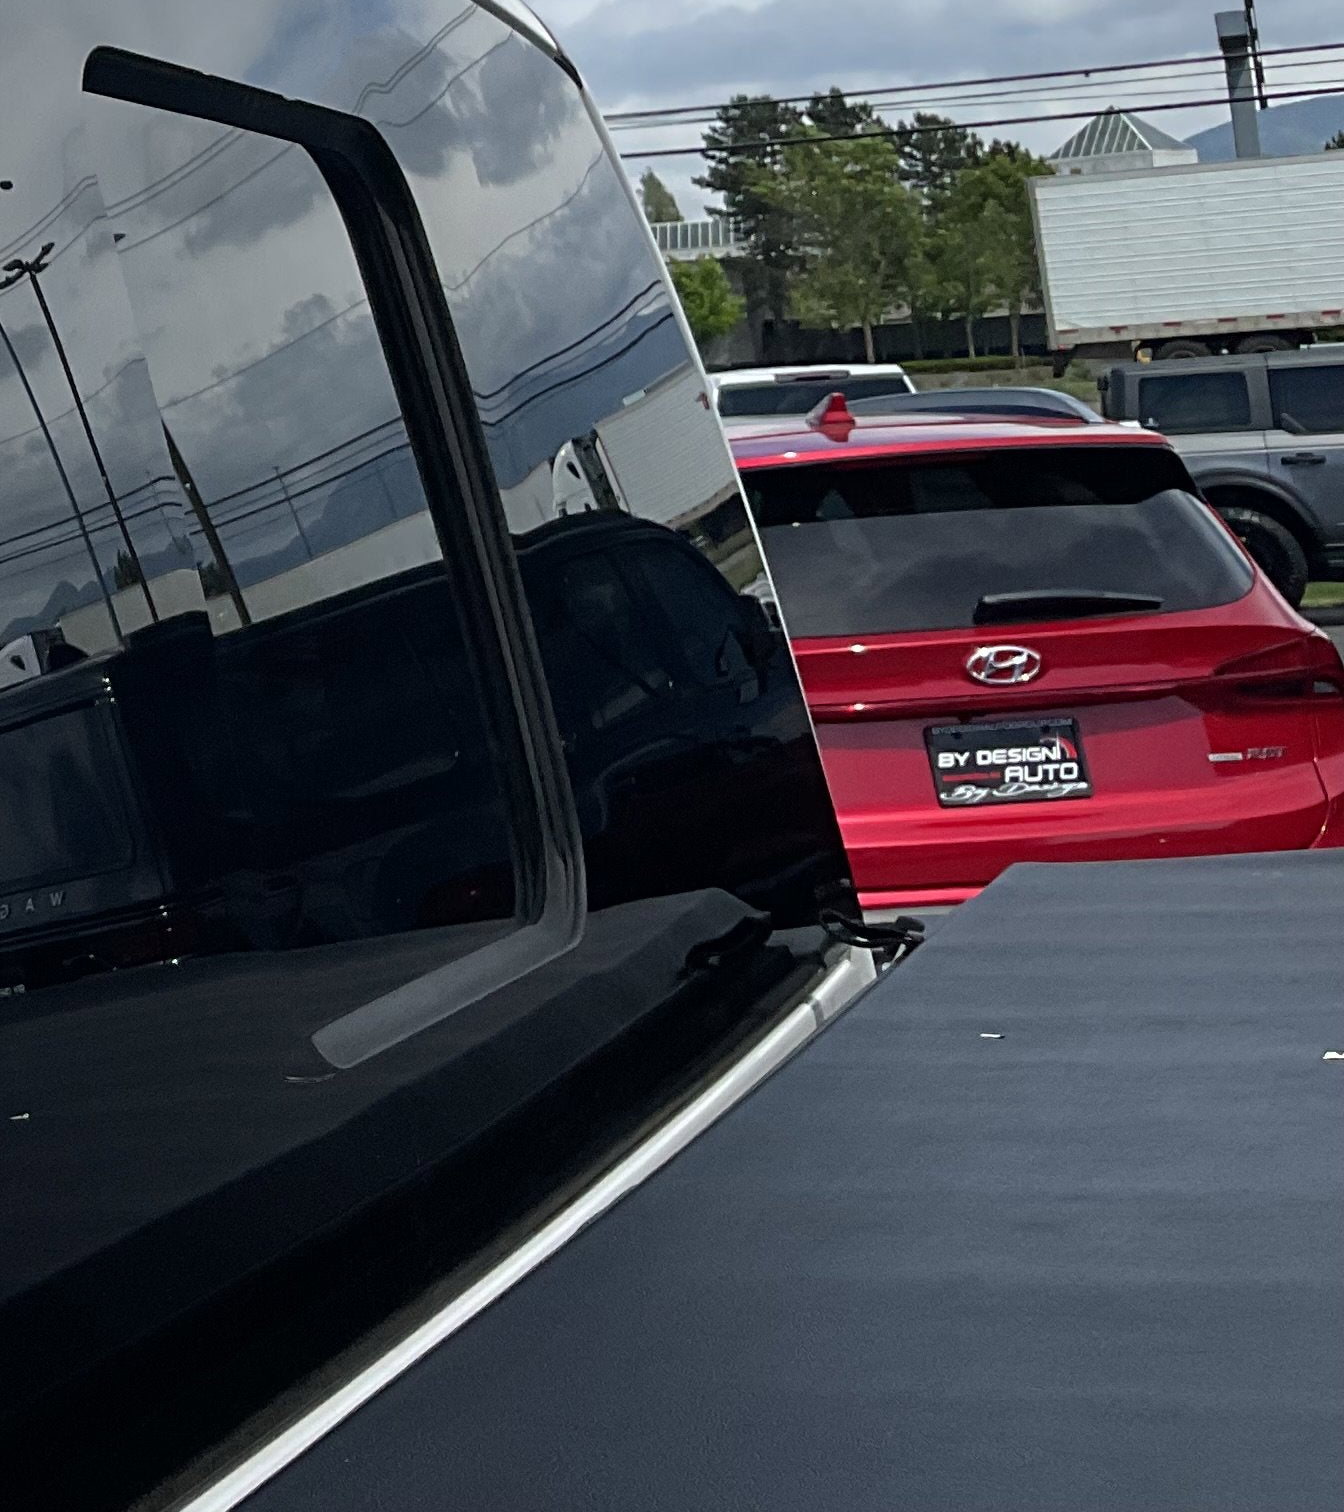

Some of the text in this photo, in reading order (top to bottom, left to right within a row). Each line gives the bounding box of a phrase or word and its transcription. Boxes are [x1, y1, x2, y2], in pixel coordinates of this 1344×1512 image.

[938, 746, 1058, 768] BY DESIGN
[1004, 762, 1078, 783] AUTO
[940, 785, 989, 803] By
